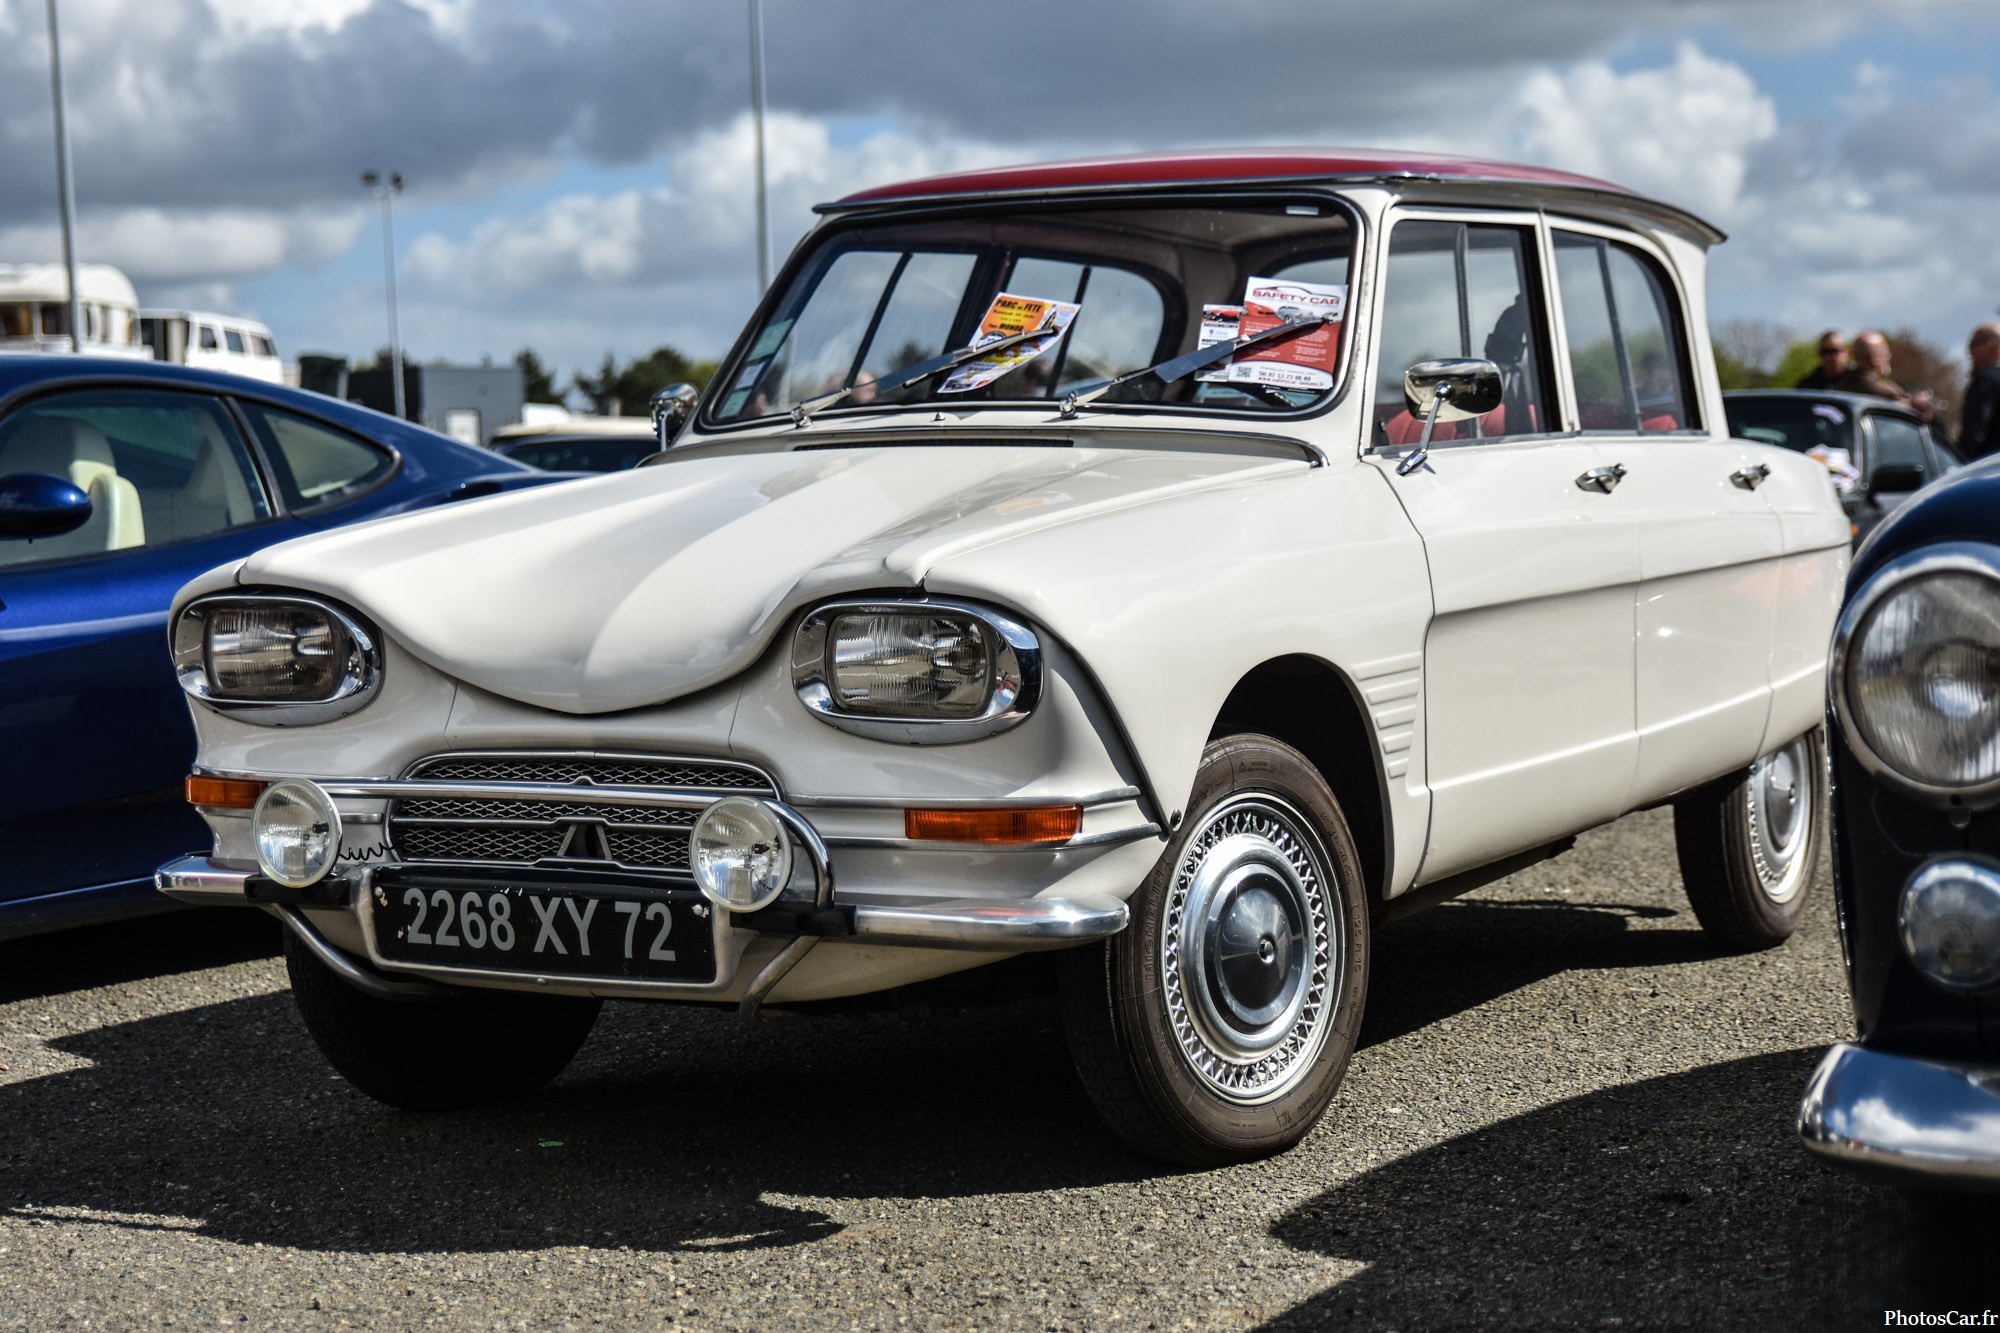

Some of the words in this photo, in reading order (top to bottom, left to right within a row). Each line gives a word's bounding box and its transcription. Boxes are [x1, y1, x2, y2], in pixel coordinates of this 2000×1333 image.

[996, 298, 1017, 309] PARC
[1252, 290, 1308, 302] SAFETY
[1310, 297, 1341, 305] CAR
[403, 887, 516, 952] 2268
[529, 895, 600, 956] XY
[615, 901, 677, 962] 72
[1144, 869, 1165, 982] MICHELIN
